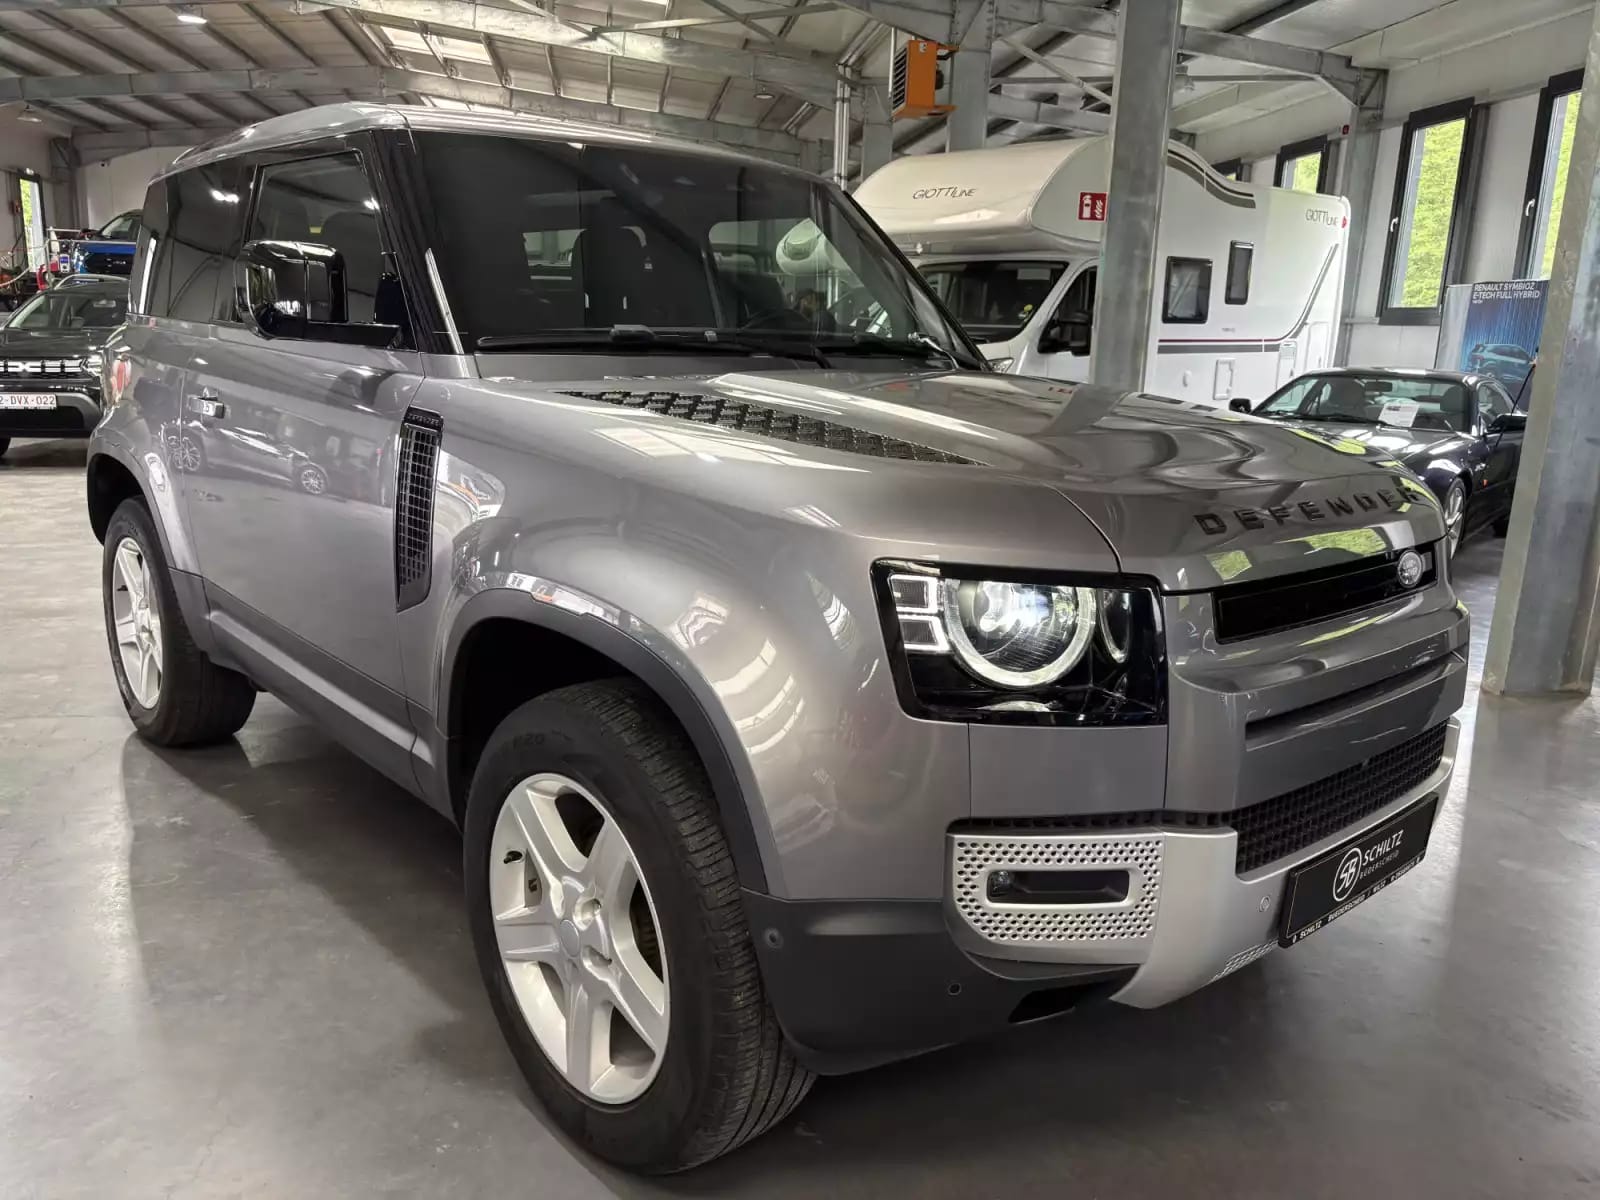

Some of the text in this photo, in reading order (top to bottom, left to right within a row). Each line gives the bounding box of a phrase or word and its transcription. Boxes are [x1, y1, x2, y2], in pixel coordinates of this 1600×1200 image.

[1472, 290, 1541, 300] E-TECH FULL HYBRID
[1474, 283, 1504, 291] RENAULT
[1193, 486, 1420, 536] DEFENDER
[1362, 829, 1404, 866] SCHILTZ
